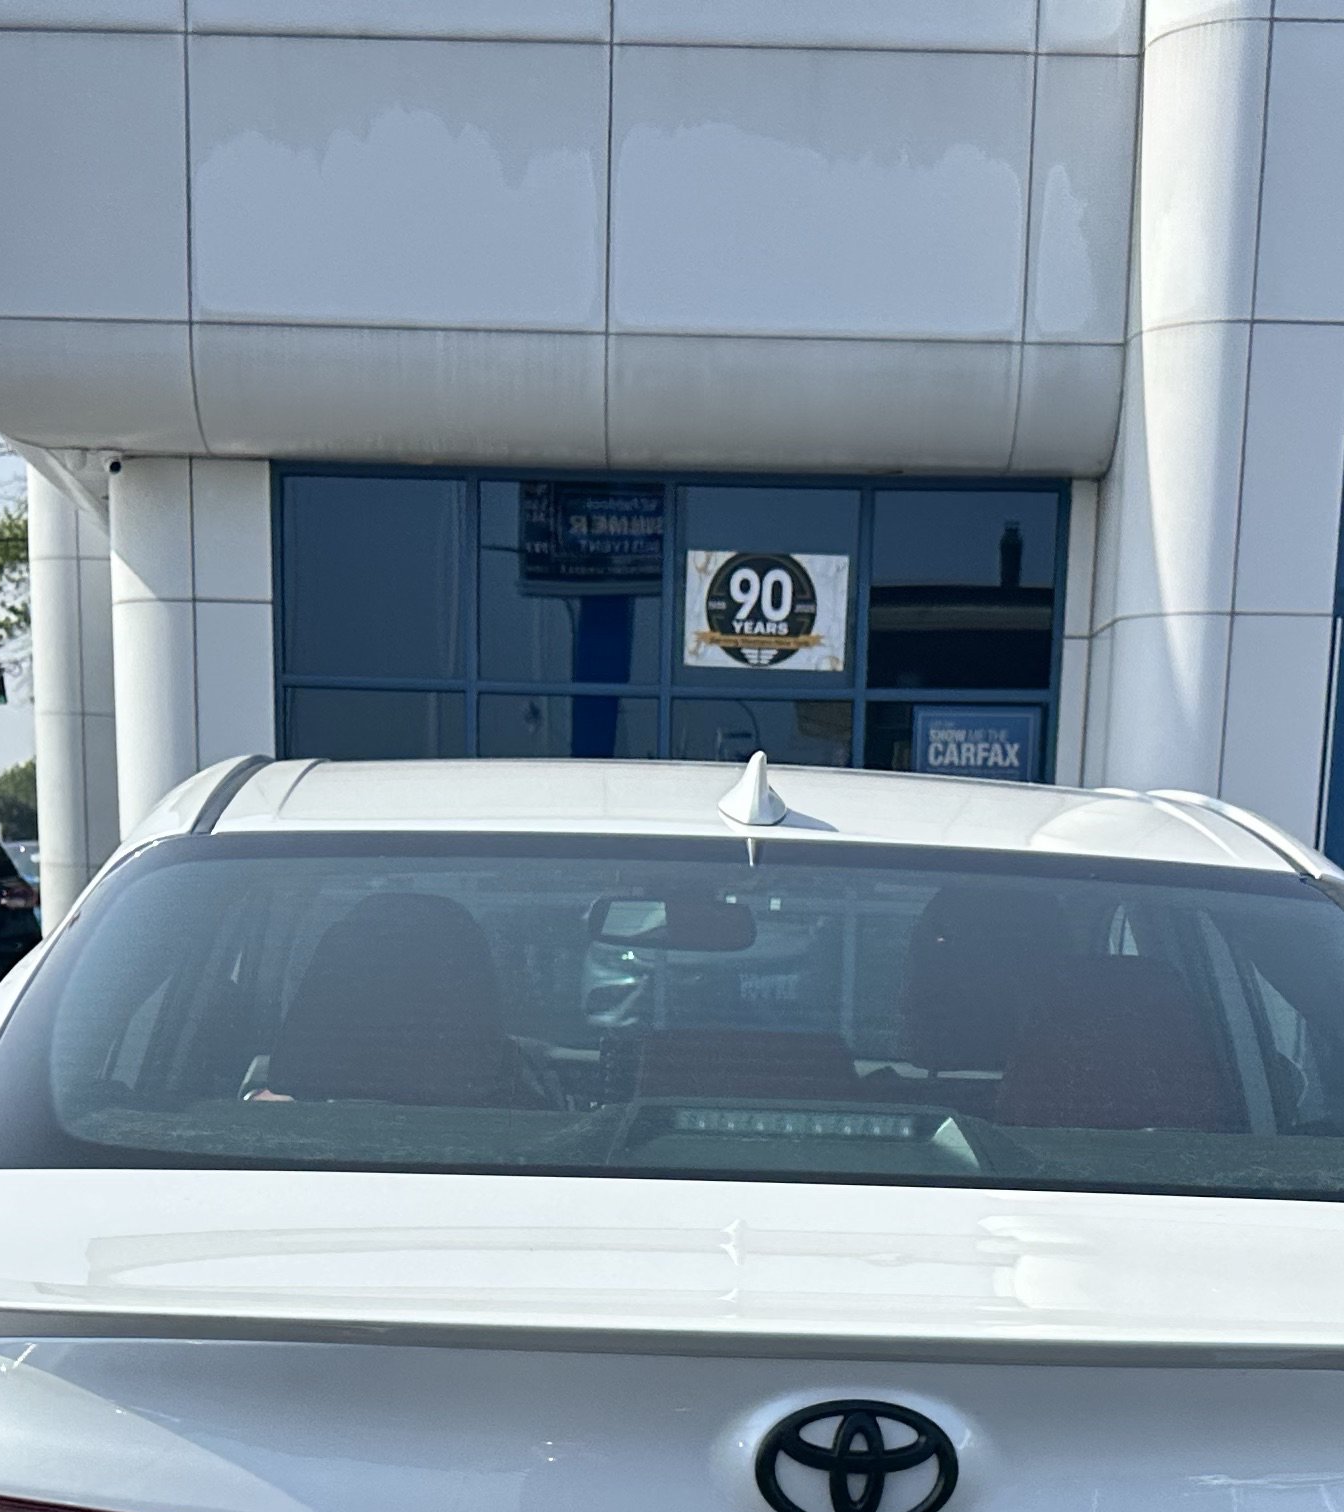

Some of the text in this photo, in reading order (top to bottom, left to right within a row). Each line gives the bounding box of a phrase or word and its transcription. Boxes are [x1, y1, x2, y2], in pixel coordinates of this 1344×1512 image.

[730, 563, 793, 622] 90
[732, 620, 789, 636] YEARS
[928, 742, 1020, 767] CARFAX
